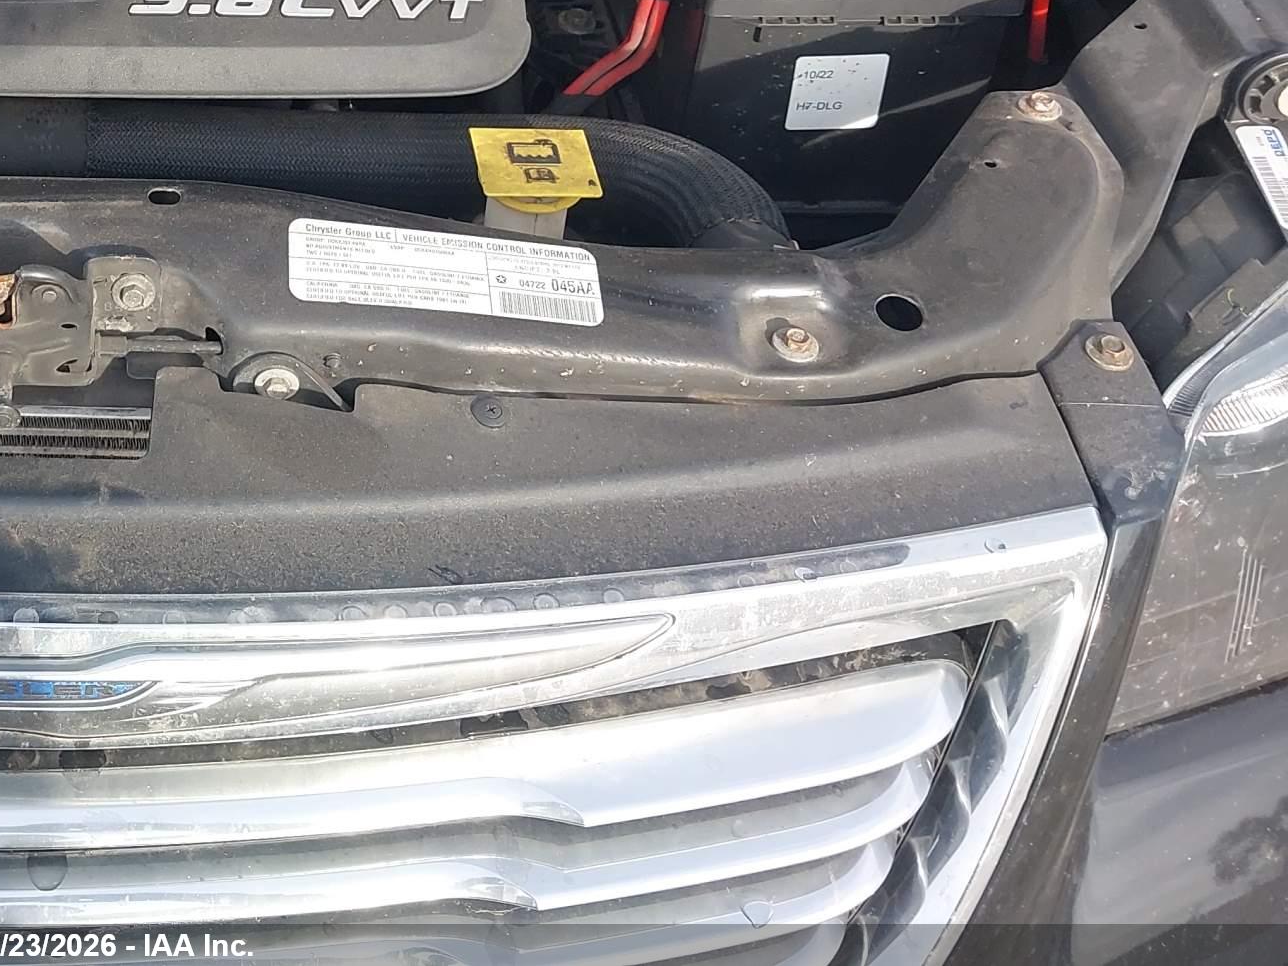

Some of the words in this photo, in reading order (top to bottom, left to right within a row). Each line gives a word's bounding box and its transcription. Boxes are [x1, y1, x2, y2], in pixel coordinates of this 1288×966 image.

[795, 101, 843, 111] H7-DLG
[1263, 128, 1286, 157] DEPO
[305, 223, 345, 235] Chrysler
[345, 227, 372, 239] Group
[375, 230, 392, 240] LLC
[402, 233, 438, 246] VEHICLE
[441, 237, 484, 249] EMISSION
[486, 242, 527, 254] CONTROL
[529, 247, 591, 261] INFORMATION
